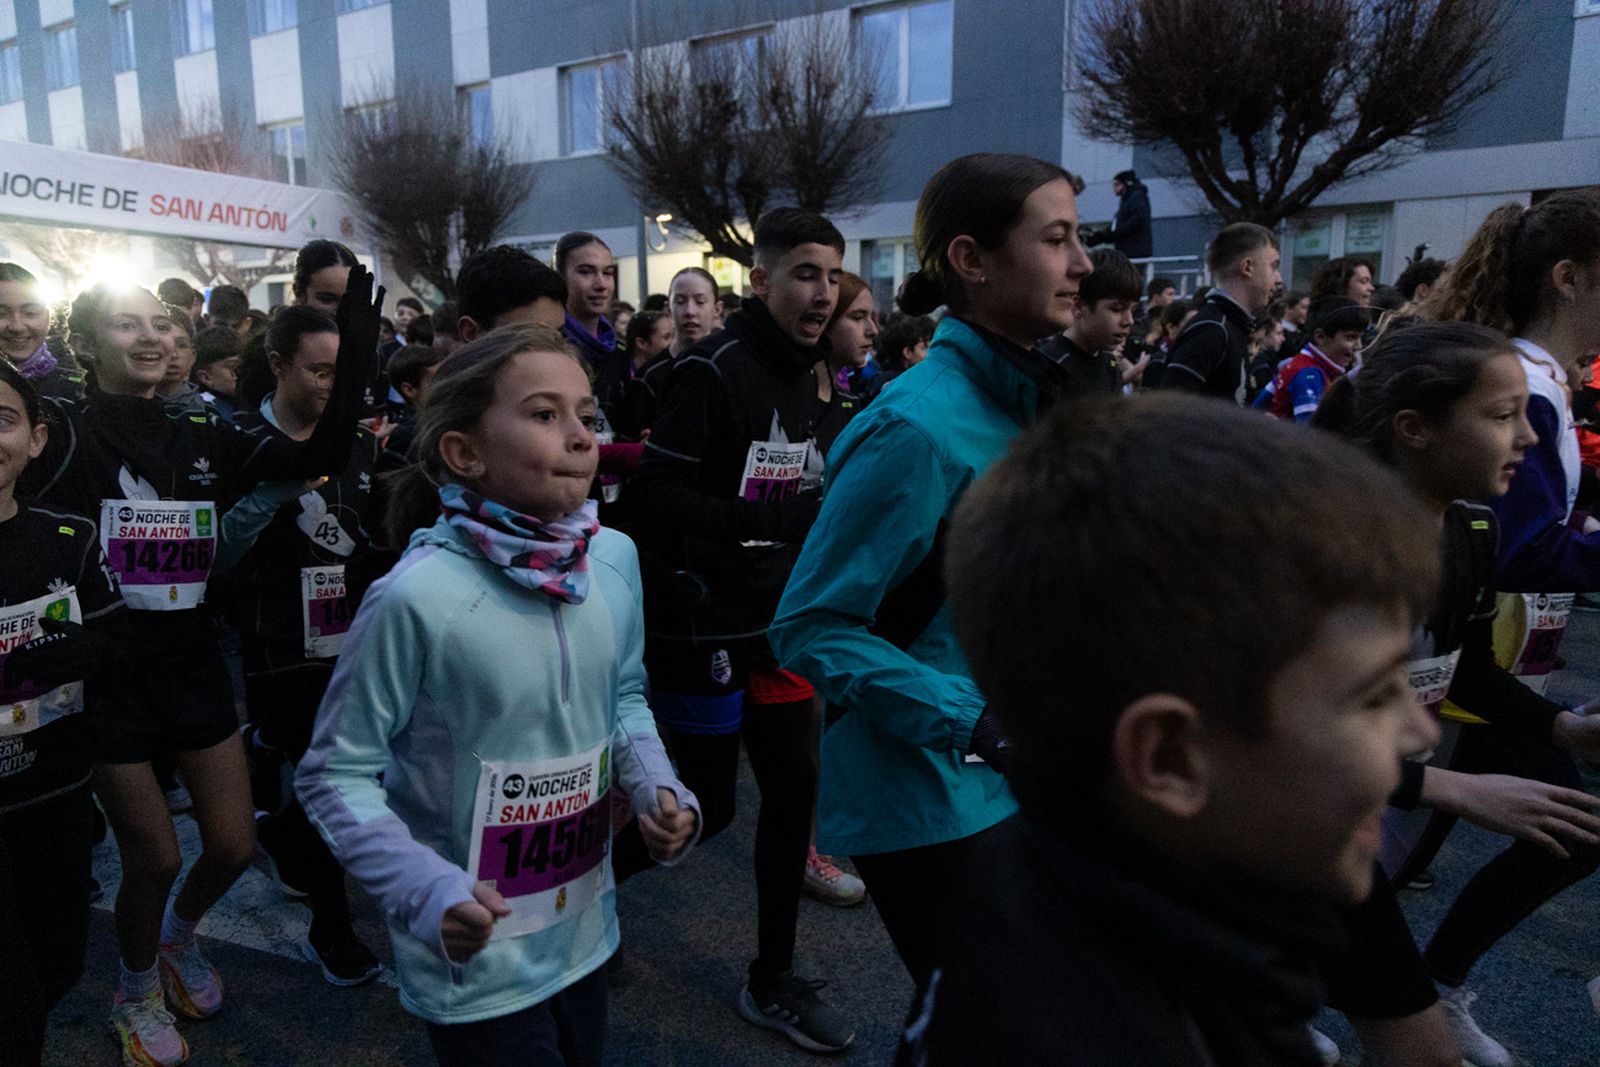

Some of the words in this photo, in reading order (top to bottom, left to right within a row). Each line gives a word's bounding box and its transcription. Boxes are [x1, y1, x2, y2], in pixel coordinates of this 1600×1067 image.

[102, 187, 139, 213] DE
[149, 194, 203, 222] SAN
[207, 204, 289, 233] ANTÓN
[754, 466, 775, 478] SAN
[136, 513, 176, 524] NOCHE
[178, 513, 191, 524] DE
[119, 526, 147, 538] SAN
[150, 524, 190, 538] ANTÓN
[314, 521, 340, 545] 43
[120, 539, 209, 573] 14266
[316, 588, 336, 598] SAN
[22, 615, 36, 630] DE
[25, 632, 69, 651] KIPSTA
[503, 778, 524, 795] 43
[527, 775, 578, 799] NOCHE
[578, 768, 593, 788] DE
[500, 803, 540, 824] SAN
[543, 788, 590, 819] ANTÓN
[499, 806, 608, 879] 1456
